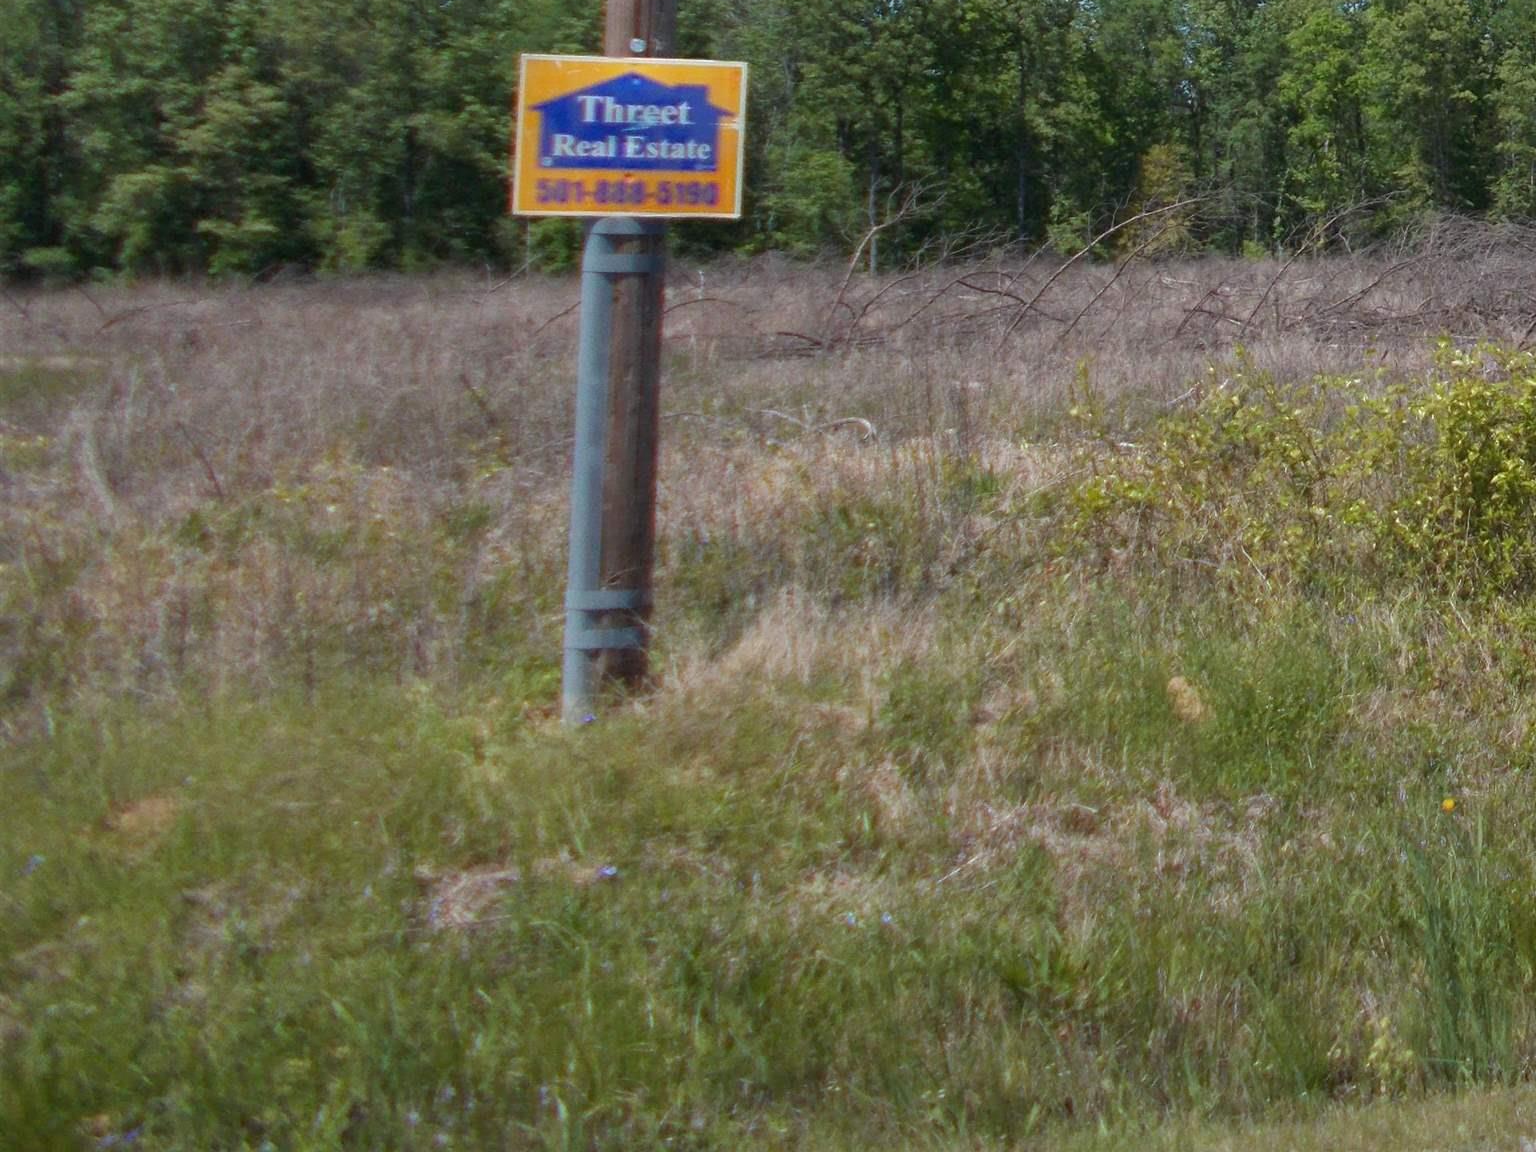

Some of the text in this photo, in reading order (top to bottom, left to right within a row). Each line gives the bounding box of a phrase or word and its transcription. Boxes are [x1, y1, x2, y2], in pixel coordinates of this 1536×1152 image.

[577, 95, 695, 125] Threet
[552, 133, 712, 160] Real Estate
